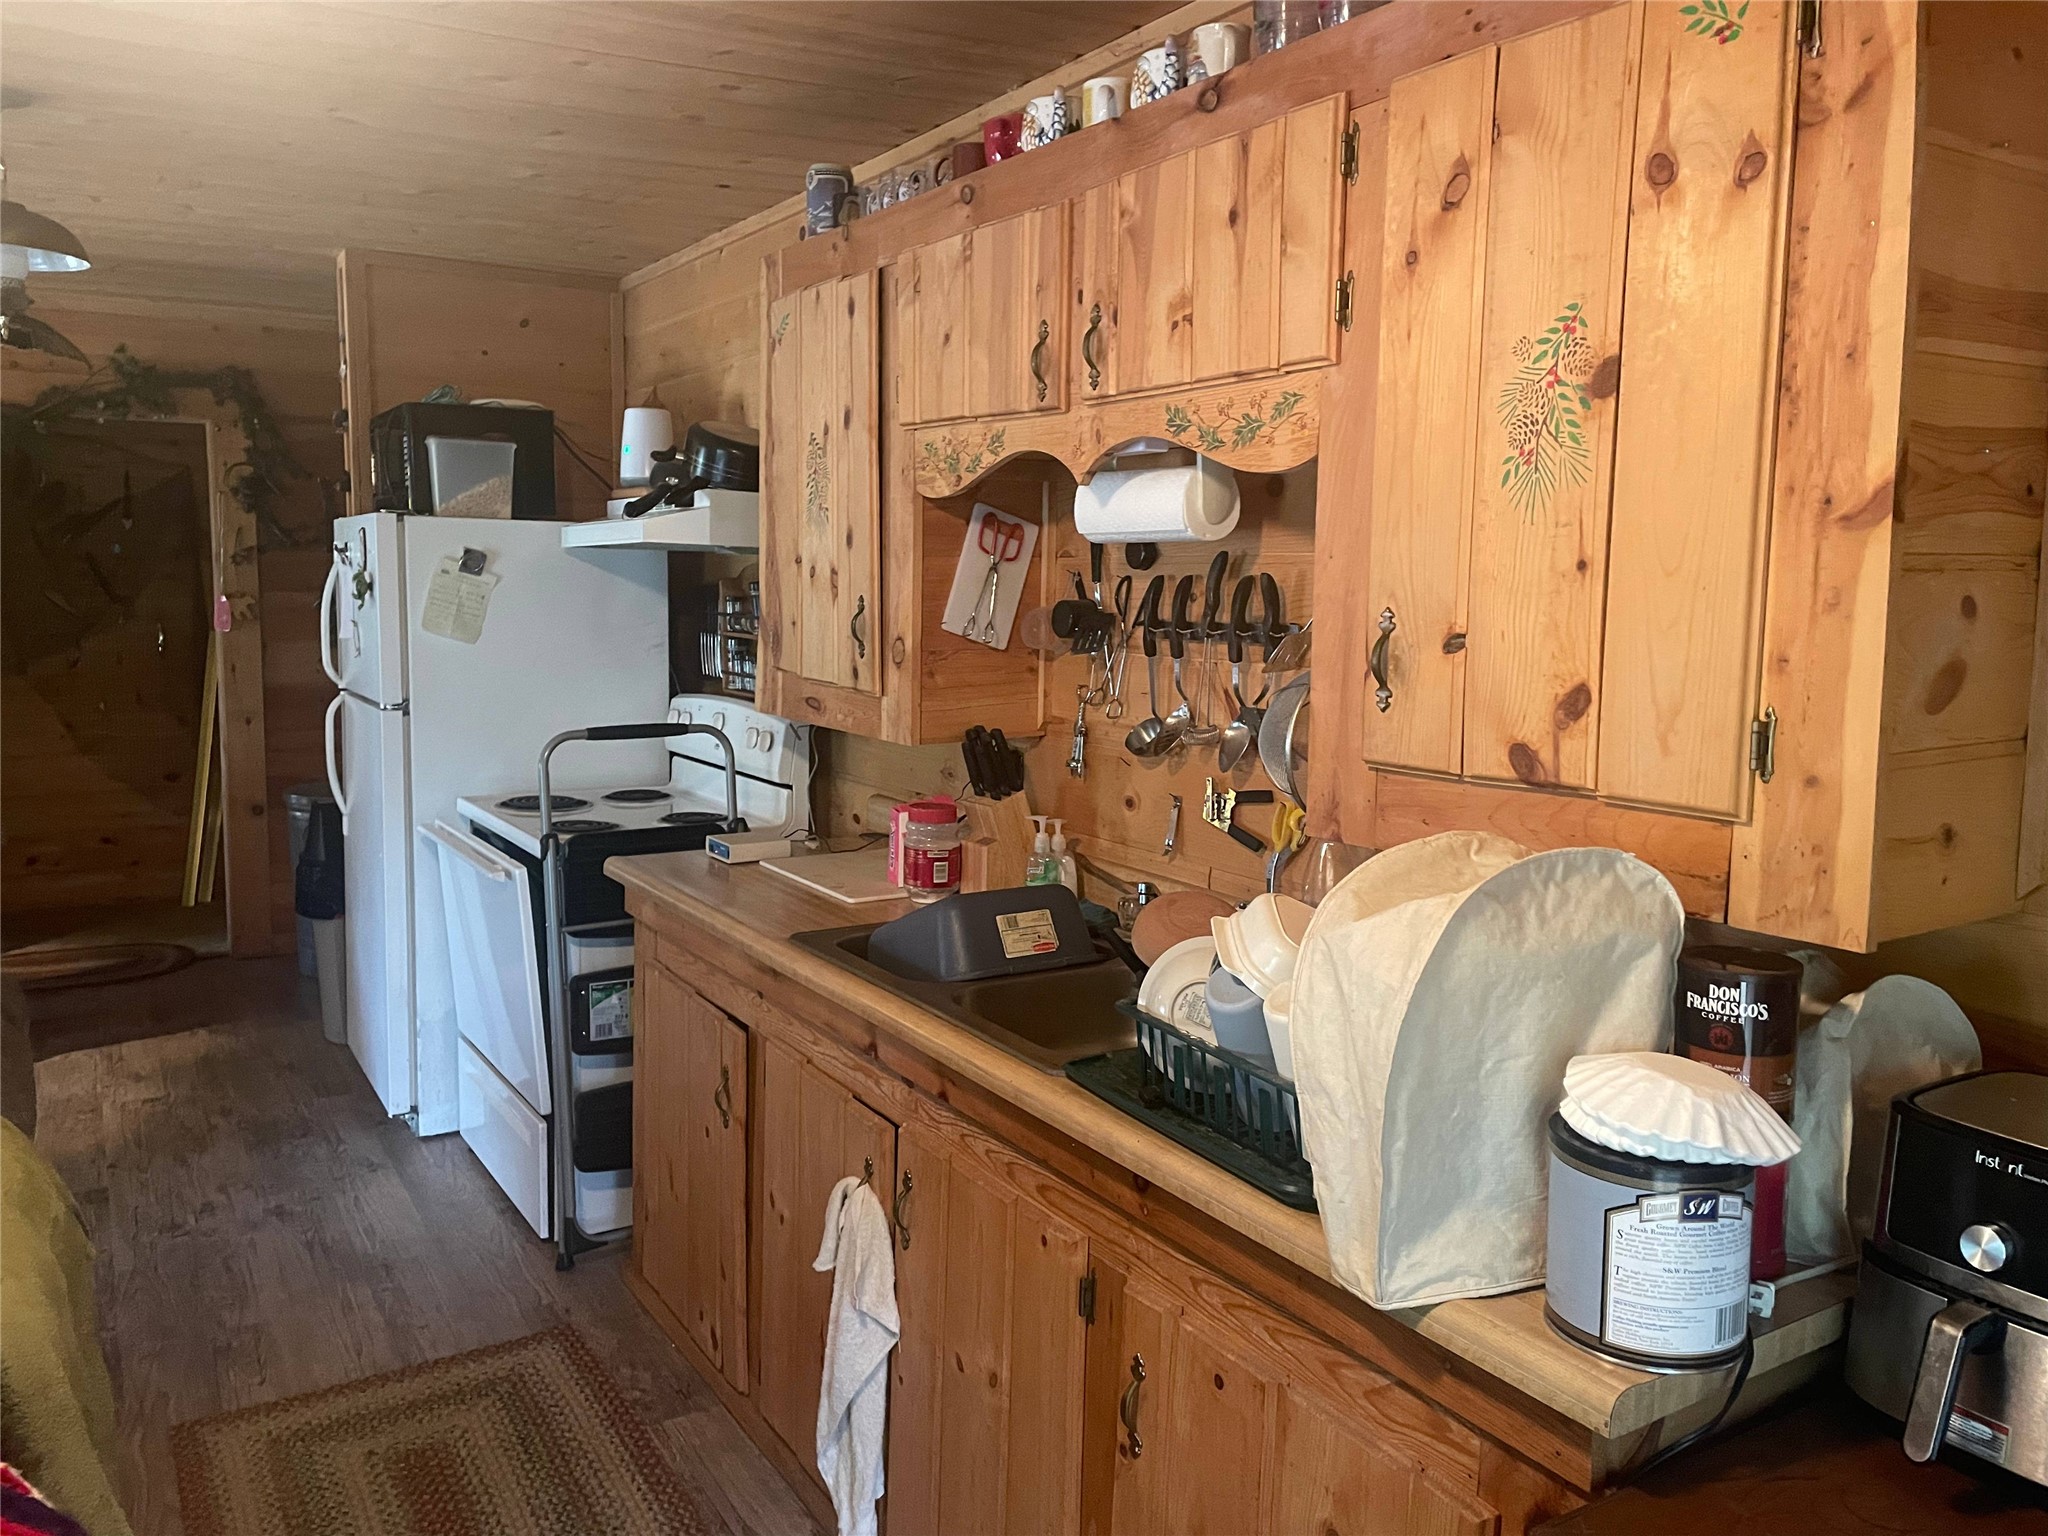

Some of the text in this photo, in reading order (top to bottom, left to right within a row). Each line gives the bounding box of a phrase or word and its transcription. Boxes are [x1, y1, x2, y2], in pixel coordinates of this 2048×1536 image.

[1709, 983, 1740, 1002] DON
[1686, 991, 1769, 1021] FRANCISCO'S
[1701, 1011, 1745, 1025] COFFEE
[1975, 1149, 2025, 1178] Instnt
[1646, 1202, 1678, 1216] GOURMET
[1629, 1224, 1649, 1234] Fresh
[1650, 1228, 1678, 1238] Roasted
[1656, 1223, 1680, 1232] Grown
[1683, 1267, 1710, 1275] Premium
